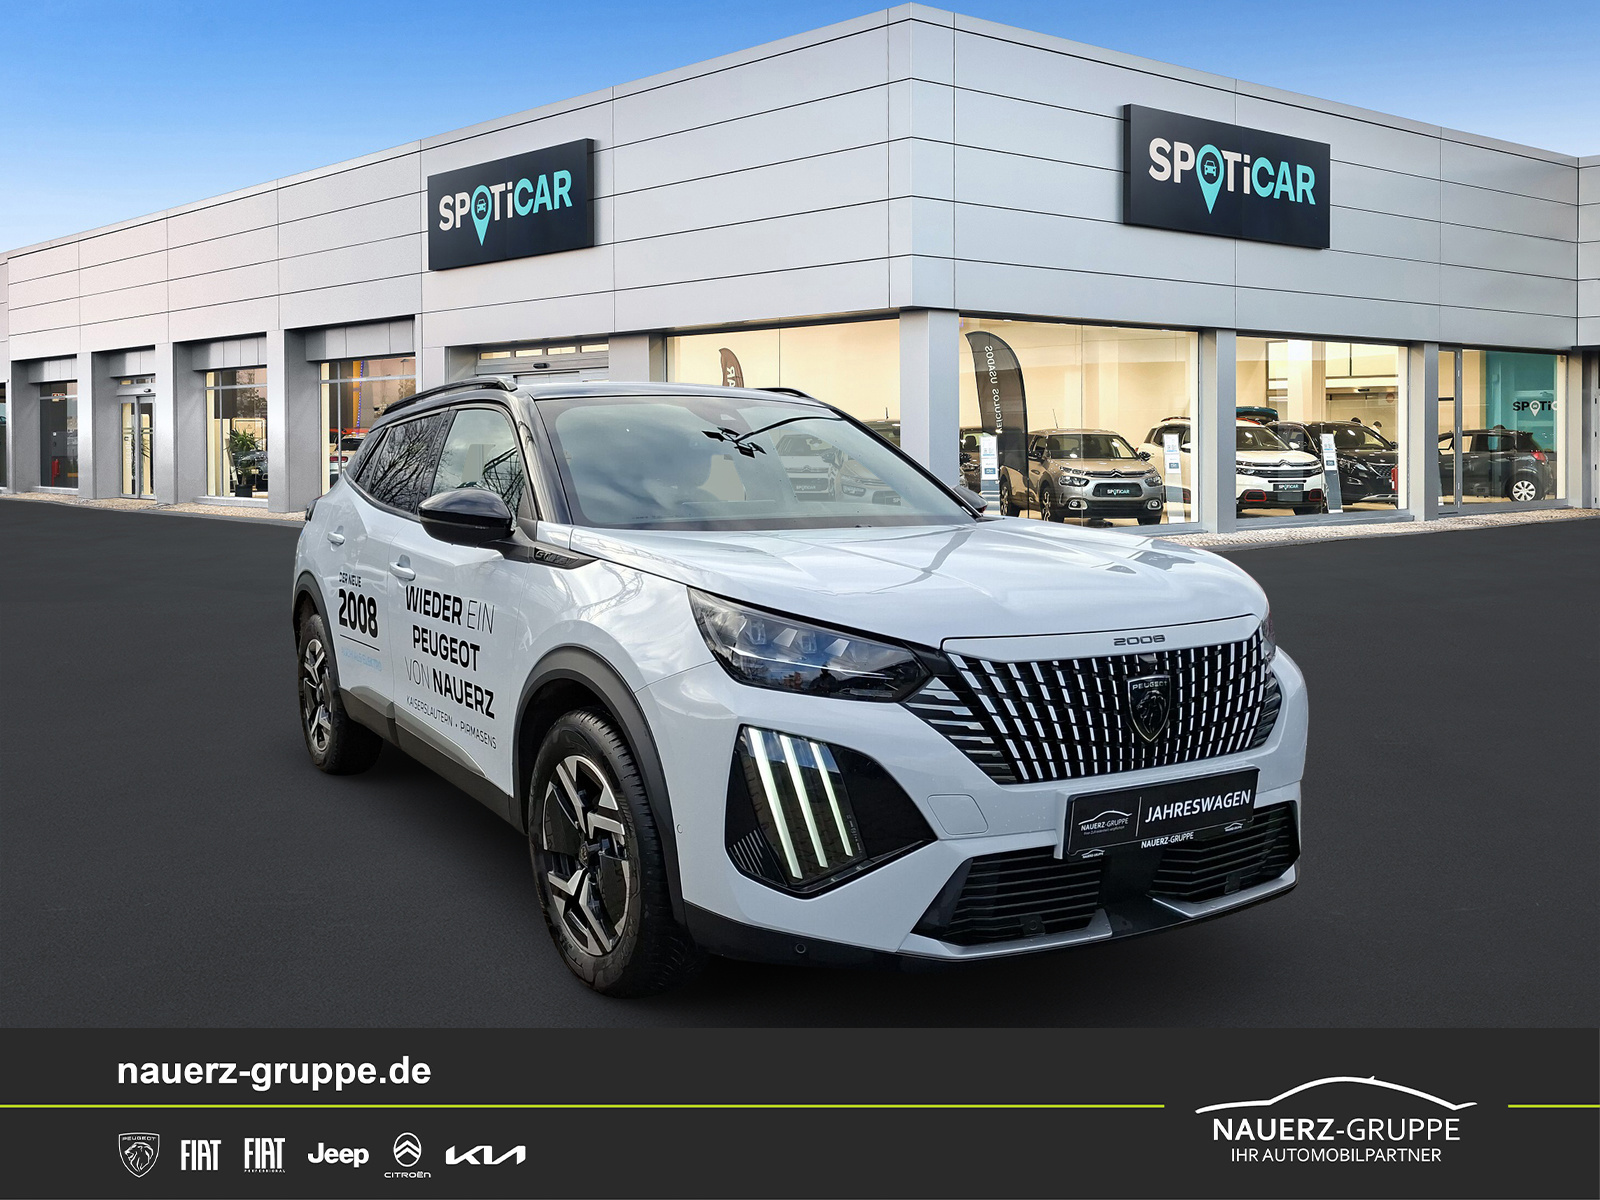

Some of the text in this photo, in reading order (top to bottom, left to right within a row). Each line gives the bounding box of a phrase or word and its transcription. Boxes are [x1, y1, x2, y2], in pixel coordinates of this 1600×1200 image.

[339, 571, 362, 588] DER NEUE
[338, 588, 379, 638] 2008
[405, 585, 495, 634] WIEDER EIN
[412, 624, 480, 672] PEUGEOT
[1113, 634, 1166, 646] 2008
[404, 656, 495, 719] VON NAUERZ
[1132, 680, 1168, 690] PEUGEOT
[406, 694, 497, 749] KAISERSLAUTERN PIRMASENS
[1145, 788, 1251, 823] JAHRESWAGEN
[1080, 817, 1129, 831] NAUERZ-GRUPPE
[1141, 831, 1194, 849] NAUERZ-GRUPPE
